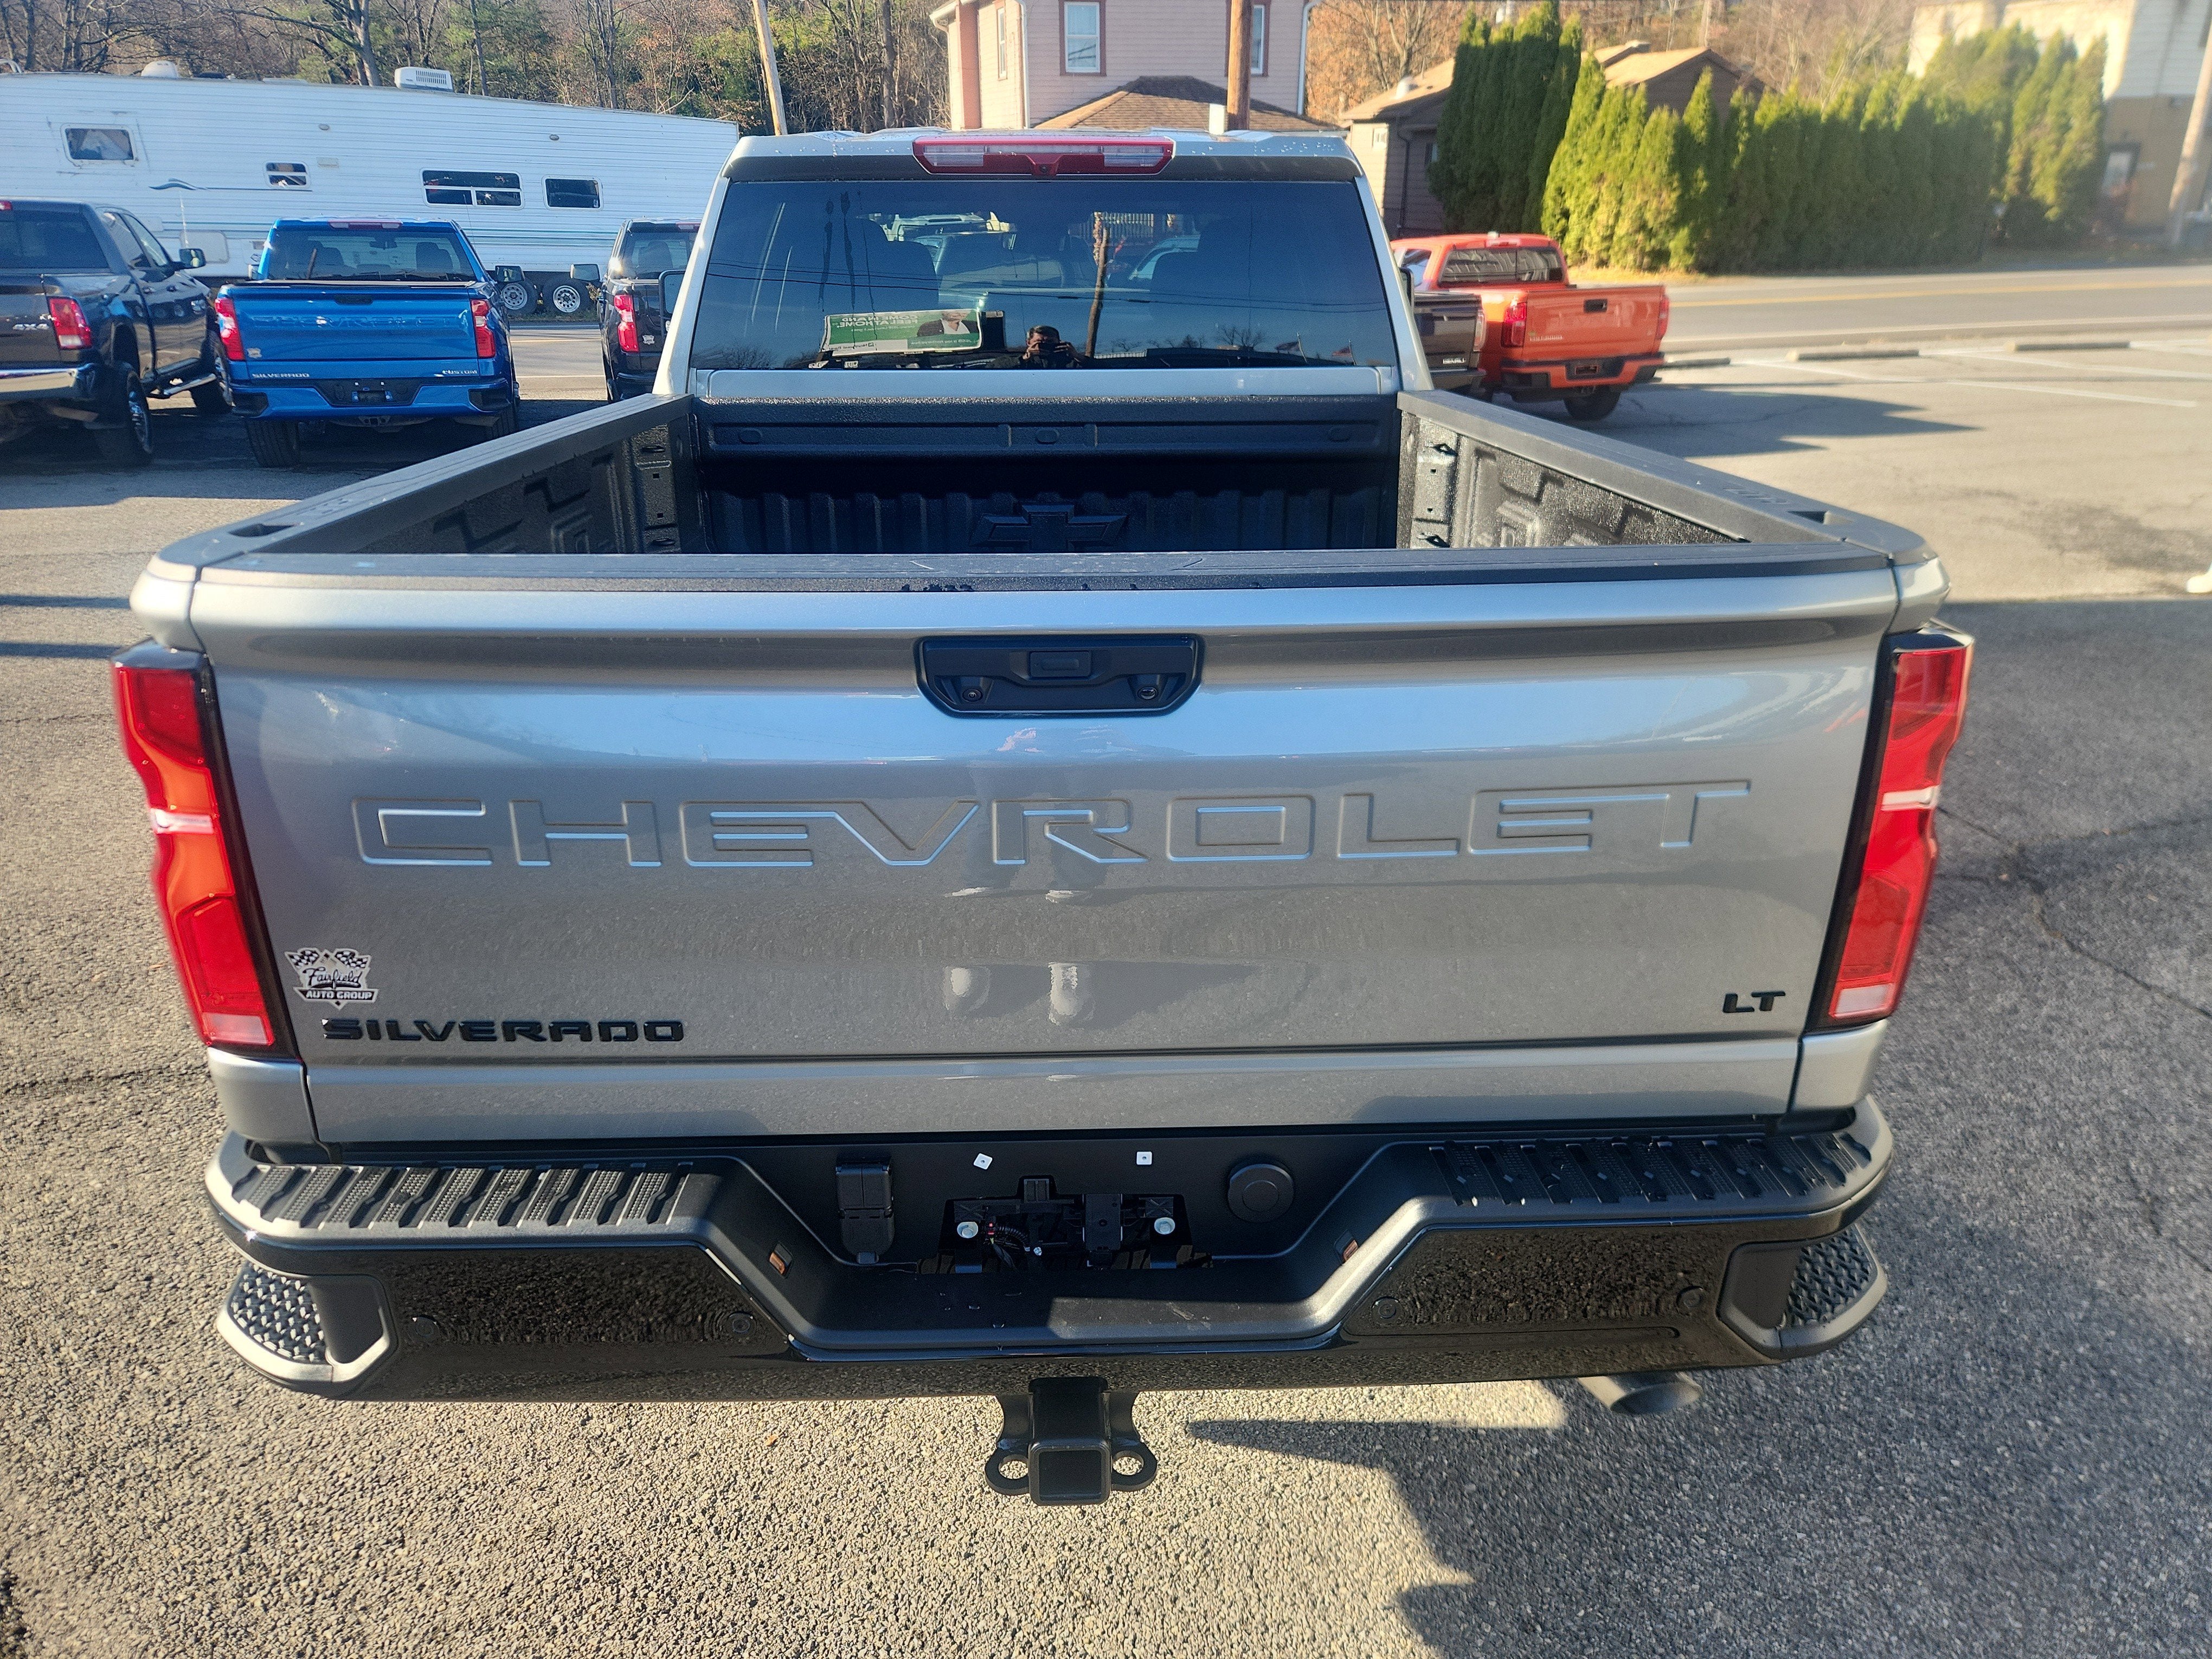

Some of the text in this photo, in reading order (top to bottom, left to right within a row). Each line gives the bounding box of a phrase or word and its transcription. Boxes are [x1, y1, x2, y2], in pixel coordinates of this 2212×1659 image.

[351, 779, 1752, 866] CHEVROLET
[303, 967, 363, 986] Fairfield
[306, 991, 373, 1000] AUTO GROUP
[1722, 991, 1786, 1013] LT
[321, 1019, 685, 1042] SILVERADO
